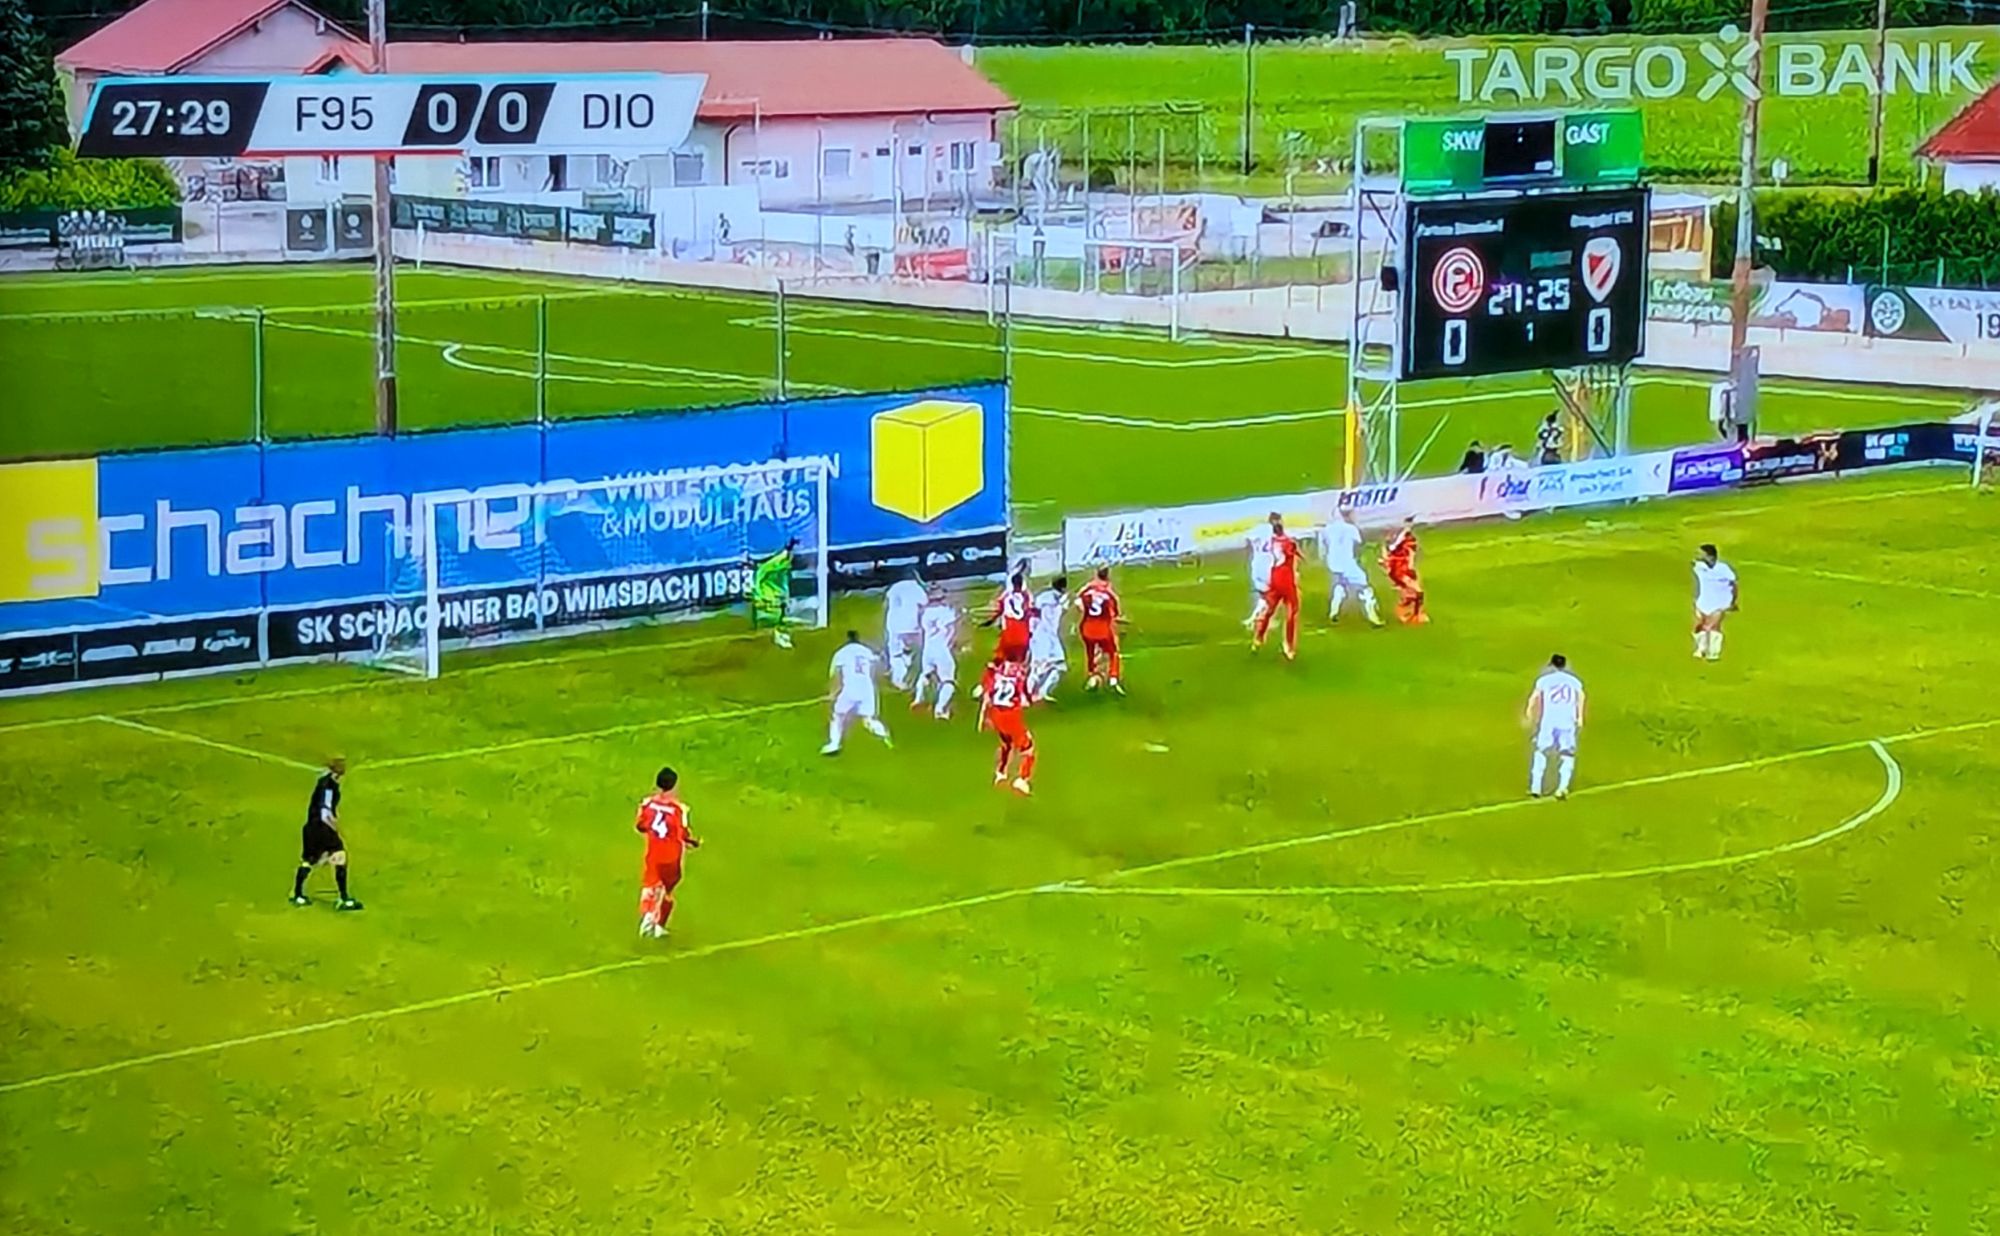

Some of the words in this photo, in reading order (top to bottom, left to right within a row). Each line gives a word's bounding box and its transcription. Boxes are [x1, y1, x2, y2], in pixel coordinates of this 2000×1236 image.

[1442, 318, 1467, 366] 0
[1525, 321, 1535, 342] 1
[1587, 307, 1611, 352] 0
[603, 453, 840, 503] WINTERGARTEN
[27, 478, 578, 593] schachner
[602, 488, 811, 539] &MODULHAUS
[297, 613, 333, 645] SK
[339, 597, 501, 640] SCHACHNER
[506, 588, 559, 619] BAD
[562, 575, 700, 614] WIMSBACH
[992, 676, 1016, 707] 22
[651, 810, 669, 839] 4
